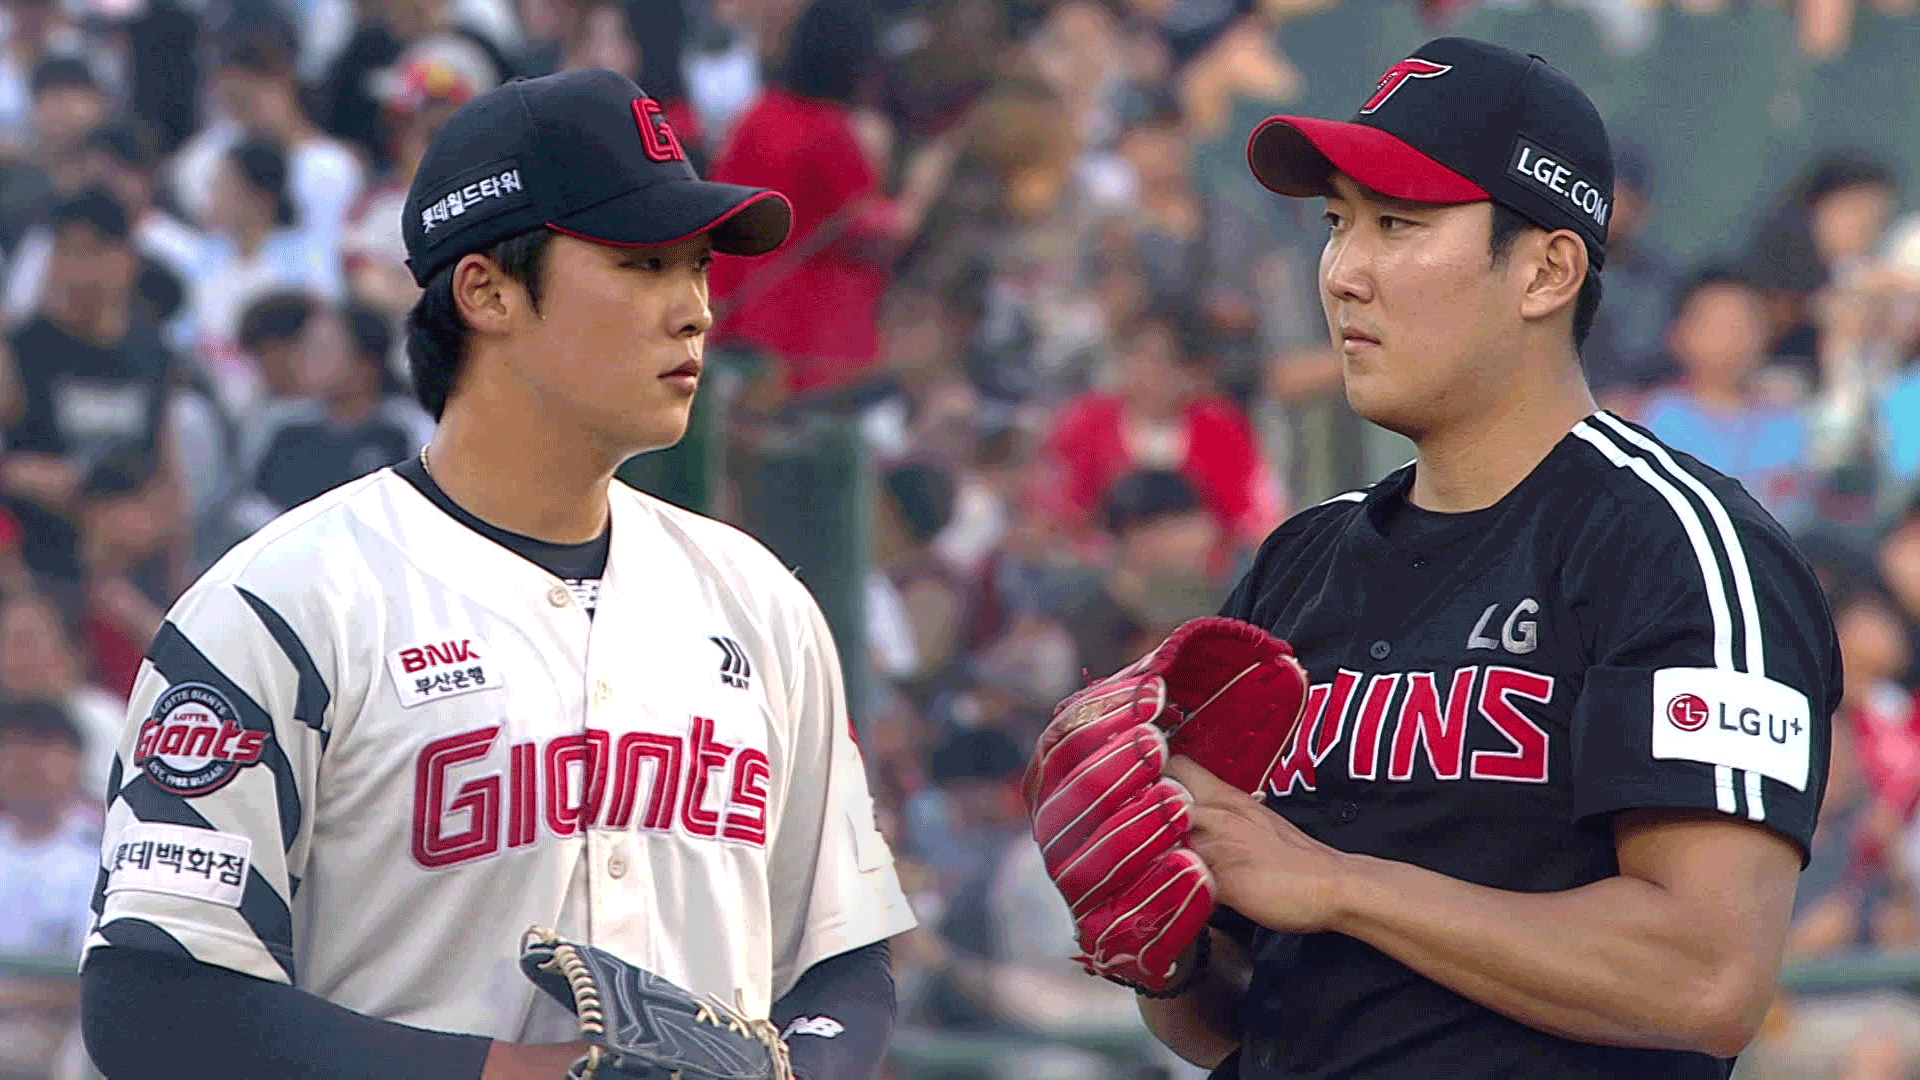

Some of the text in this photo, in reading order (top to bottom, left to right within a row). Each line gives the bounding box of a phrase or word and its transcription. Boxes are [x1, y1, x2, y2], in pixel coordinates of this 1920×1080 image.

[422, 169, 523, 233] 롯데월드타워
[1517, 147, 1608, 226] LGE.COM
[1466, 597, 1540, 655] LG
[398, 640, 480, 673] BNK
[159, 689, 228, 716] LOTTE GIANTS
[415, 666, 485, 695] 부산은행
[173, 713, 208, 722] LOTTE
[410, 715, 771, 870] Giants
